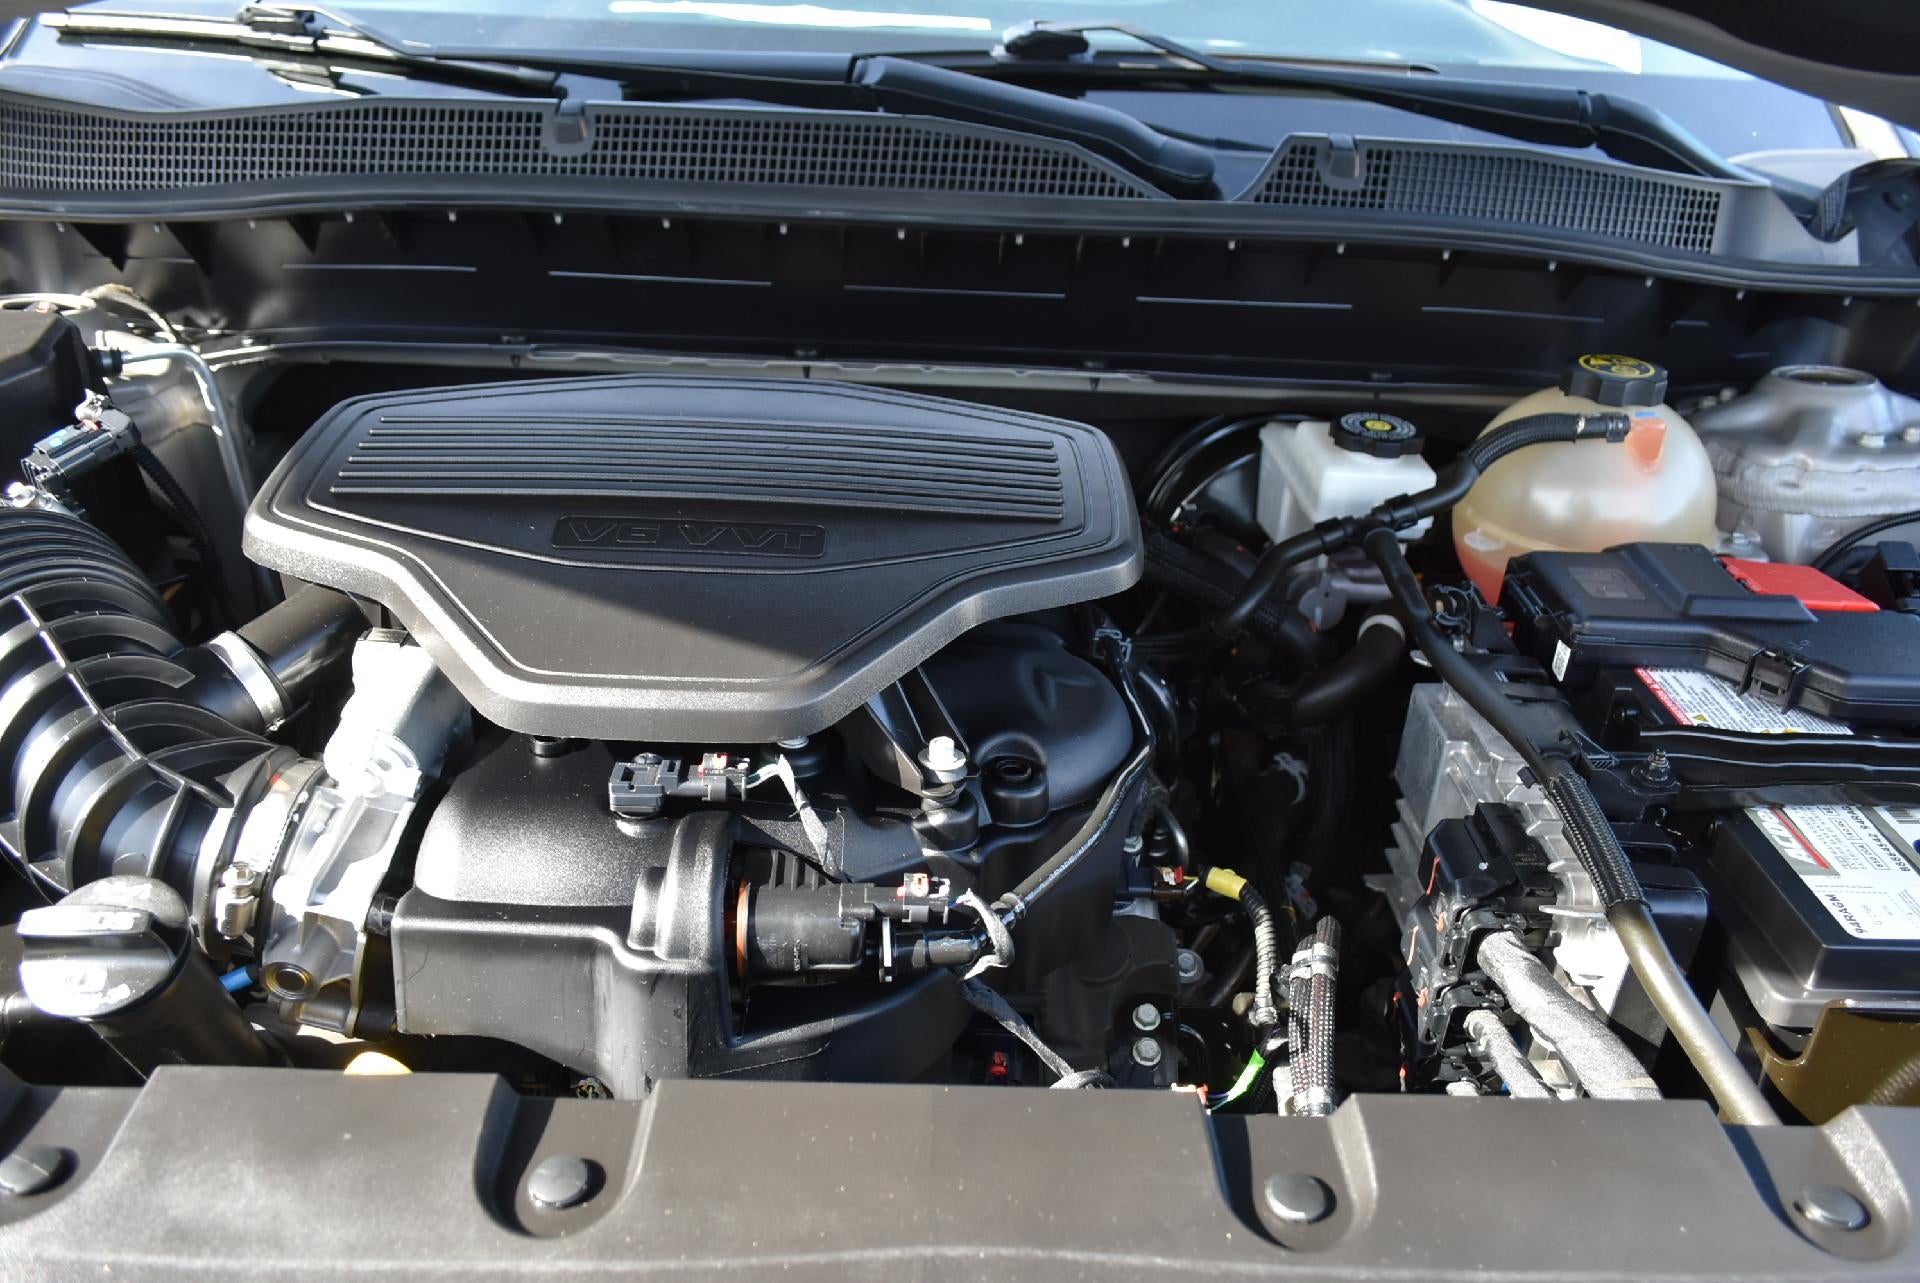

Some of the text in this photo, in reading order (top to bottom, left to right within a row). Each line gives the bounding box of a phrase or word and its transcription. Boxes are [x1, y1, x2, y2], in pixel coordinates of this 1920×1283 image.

[569, 521, 816, 549] V6 VVT
[1756, 806, 1818, 865] ACDe
[1824, 894, 1868, 934] 94RAGM
